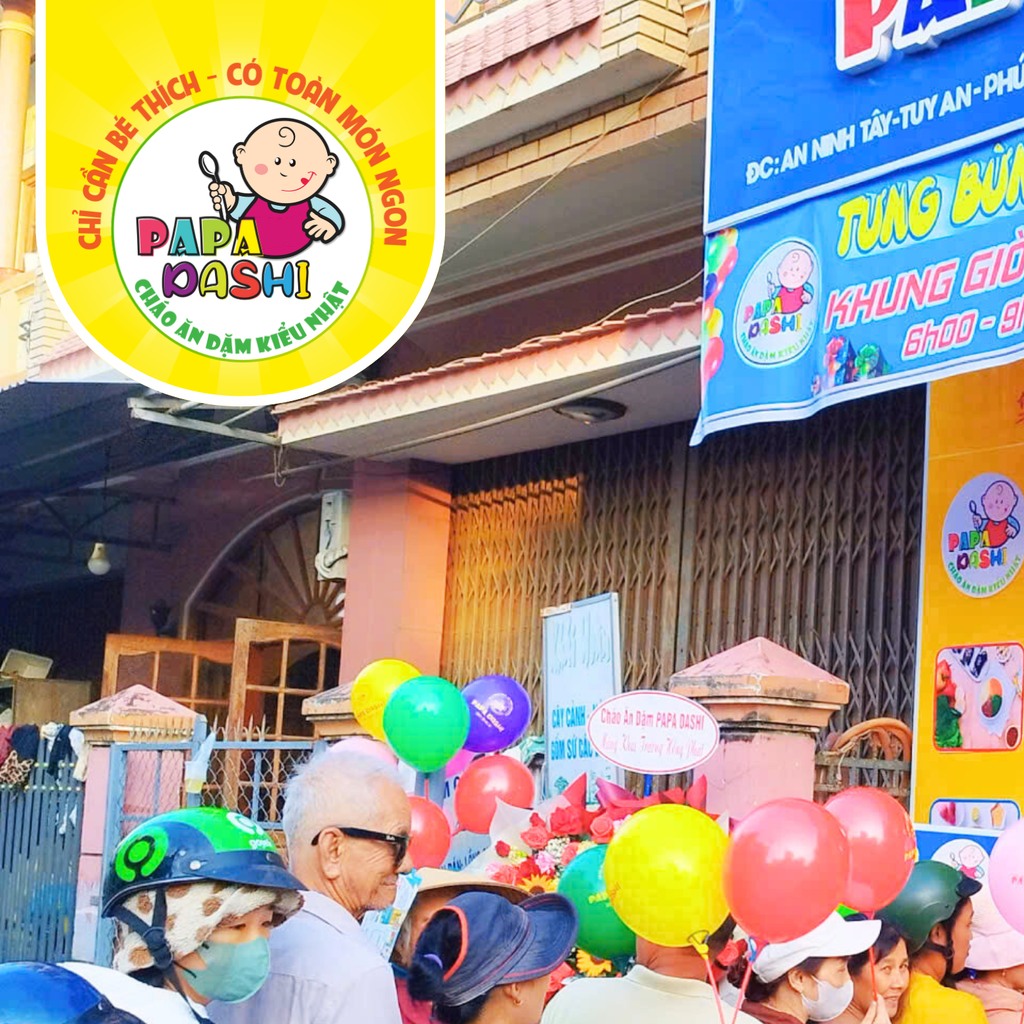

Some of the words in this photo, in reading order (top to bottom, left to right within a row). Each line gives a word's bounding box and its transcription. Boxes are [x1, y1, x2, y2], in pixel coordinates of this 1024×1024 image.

[811, 124, 855, 164] NINH
[836, 176, 940, 258] TƯNG
[824, 260, 959, 334] KHUNG
[902, 313, 976, 361] 6h00
[948, 530, 991, 552] PAPA
[957, 547, 1007, 571] DASHI
[656, 711, 677, 730] PAPA
